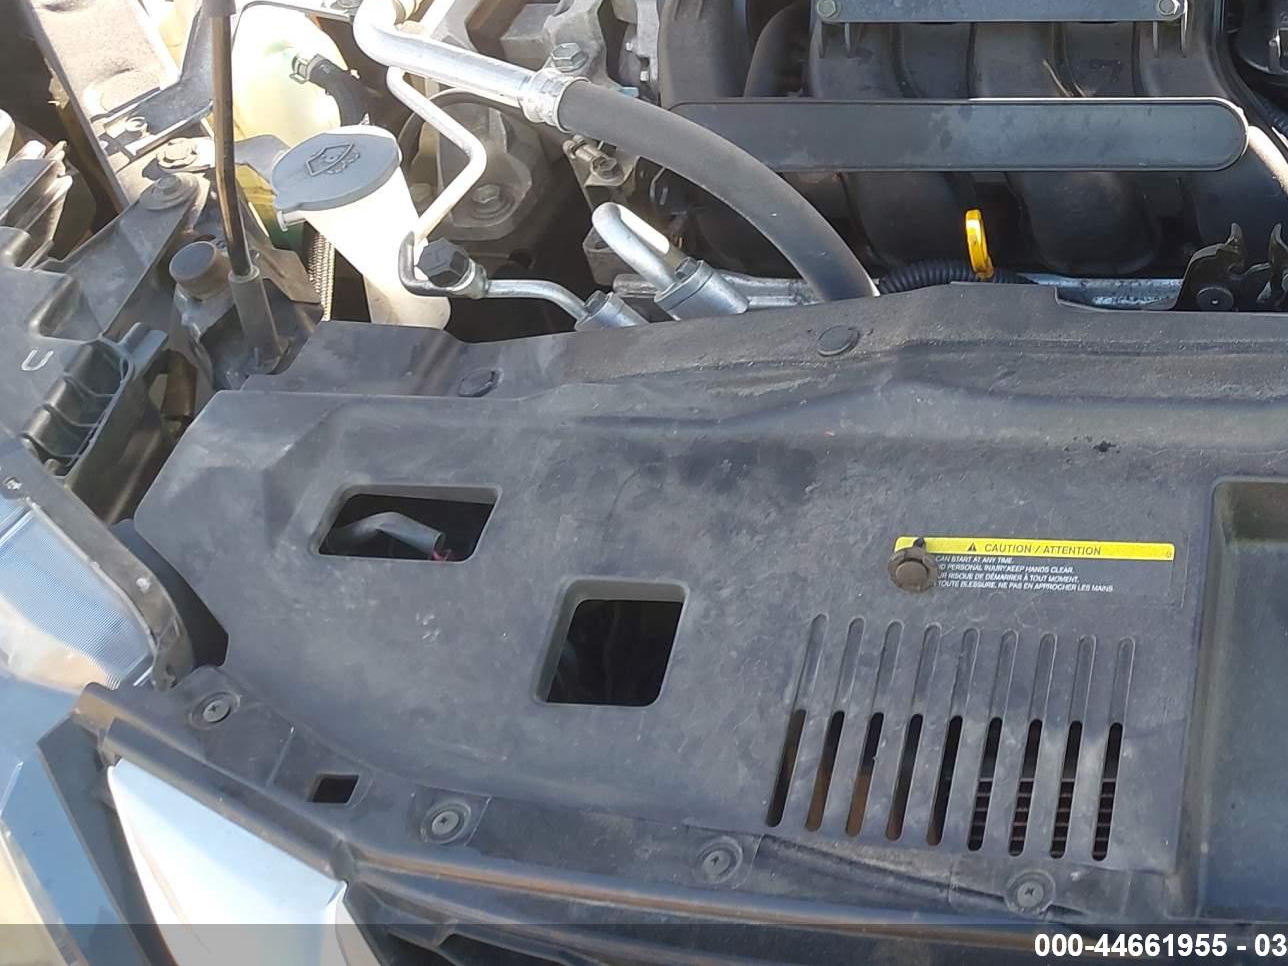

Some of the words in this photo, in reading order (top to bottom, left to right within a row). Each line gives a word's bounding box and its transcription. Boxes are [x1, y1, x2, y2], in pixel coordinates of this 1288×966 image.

[984, 543, 1032, 553] CAUTION
[1043, 545, 1101, 555] ATTENTION
[951, 555, 972, 563] START
[982, 556, 997, 564] ANY
[947, 564, 983, 572] PERSONAL
[1025, 565, 1050, 573] HANDS
[948, 572, 974, 580] RISQUE
[974, 573, 985, 581] DE
[1030, 574, 1048, 582] TOUT
[998, 581, 1009, 589] NE
[1023, 582, 1034, 590] EN
[1034, 583, 1077, 591] APPROCHER
[1077, 584, 1091, 592] LES
